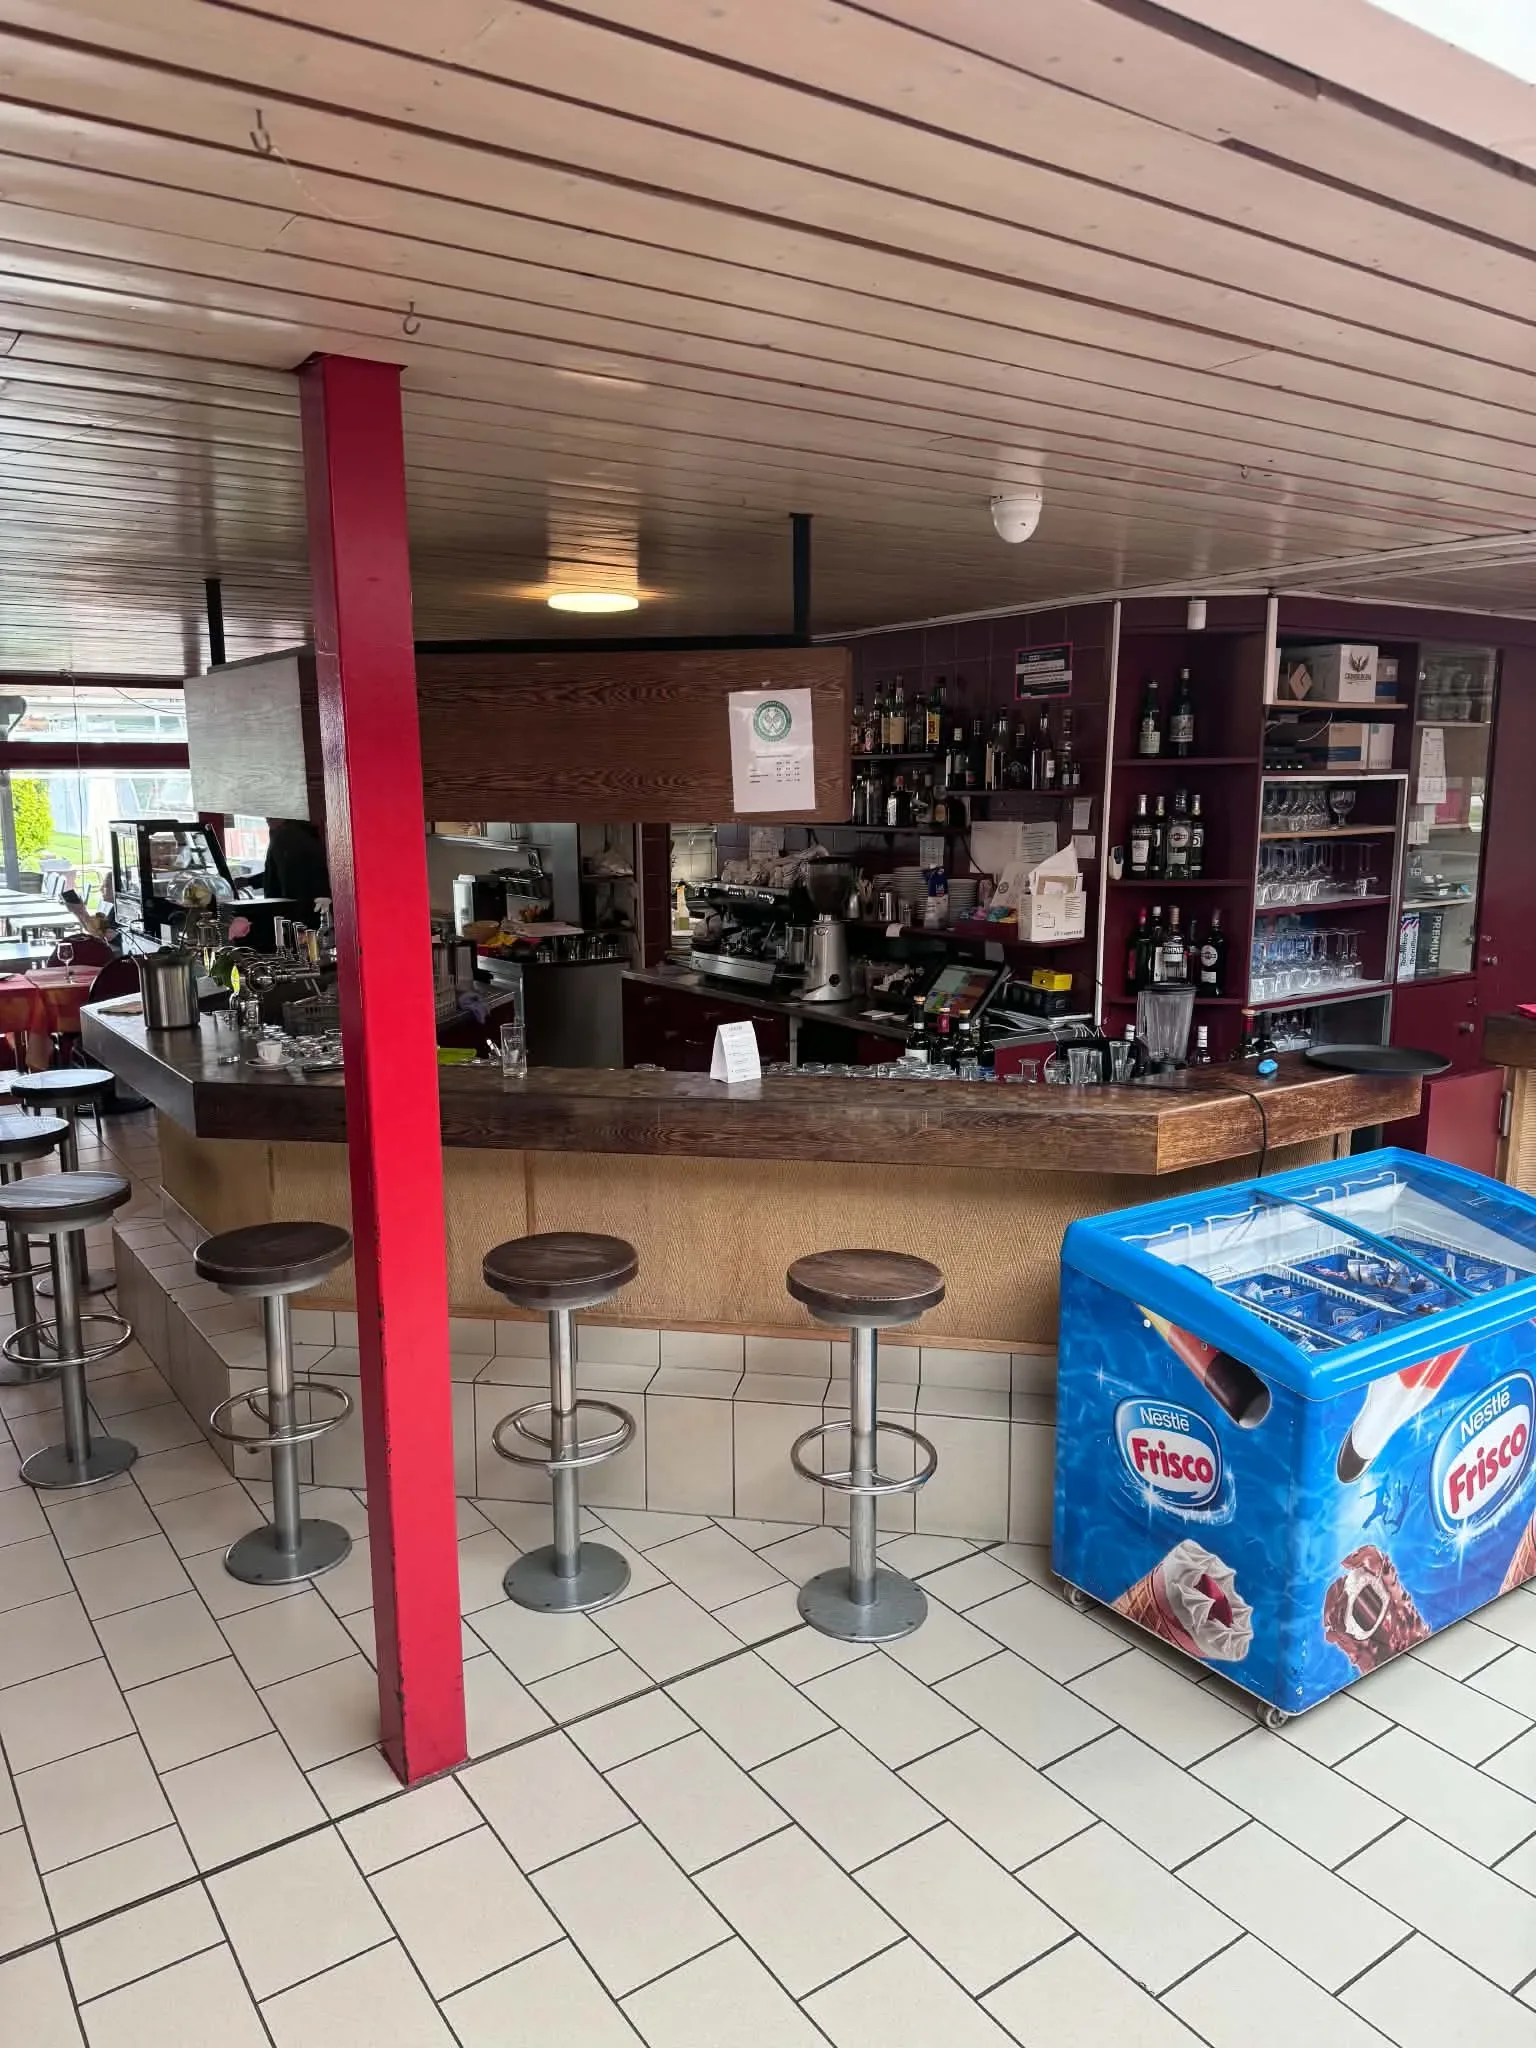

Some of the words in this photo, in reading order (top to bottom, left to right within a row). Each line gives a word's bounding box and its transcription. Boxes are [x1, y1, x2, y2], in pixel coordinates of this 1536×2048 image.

[1429, 915, 1442, 963] PREMIUM
[1139, 1406, 1190, 1432] Nestlé
[1460, 1385, 1511, 1443] Nestlé
[1131, 1437, 1214, 1483] Frisco
[1449, 1423, 1527, 1514] Frisco
